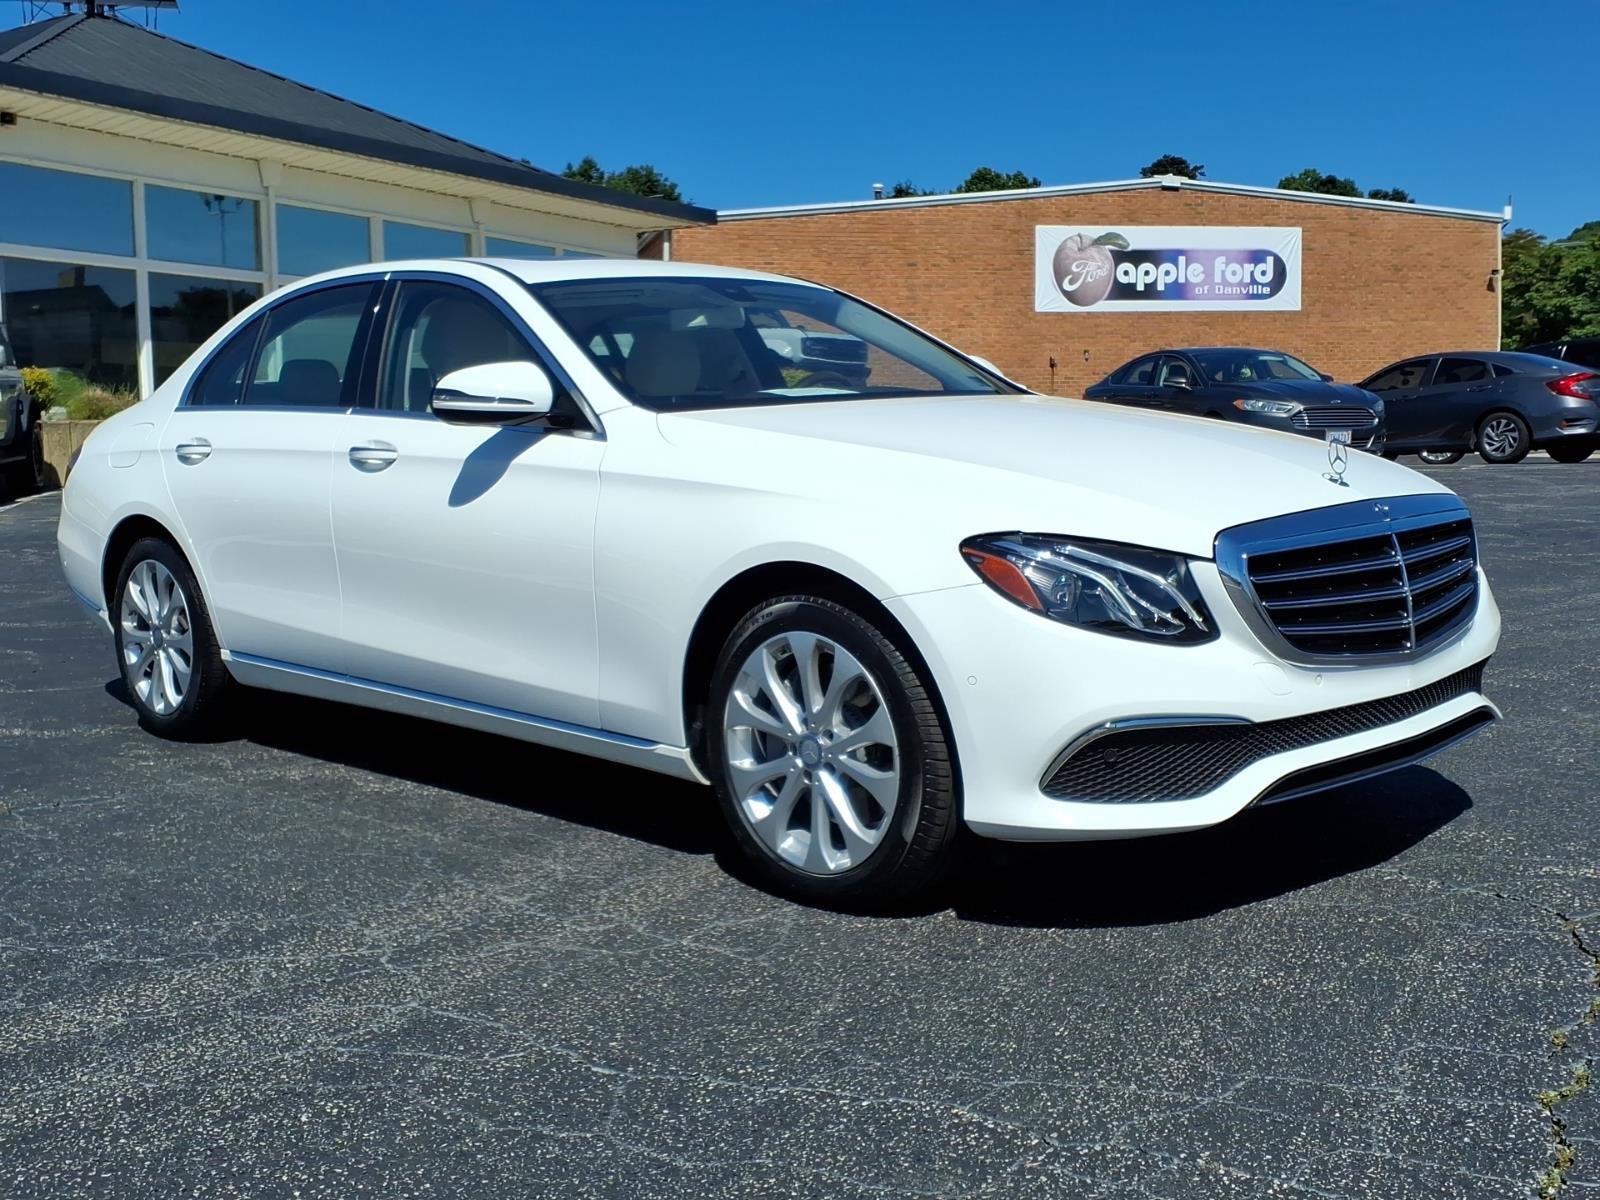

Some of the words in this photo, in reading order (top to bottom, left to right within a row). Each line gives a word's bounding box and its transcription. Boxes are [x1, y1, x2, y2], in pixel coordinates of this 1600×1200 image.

[1116, 256, 1205, 291] apple
[1214, 256, 1274, 283] ford
[1195, 285, 1209, 294] of
[1215, 285, 1271, 295] Danville
